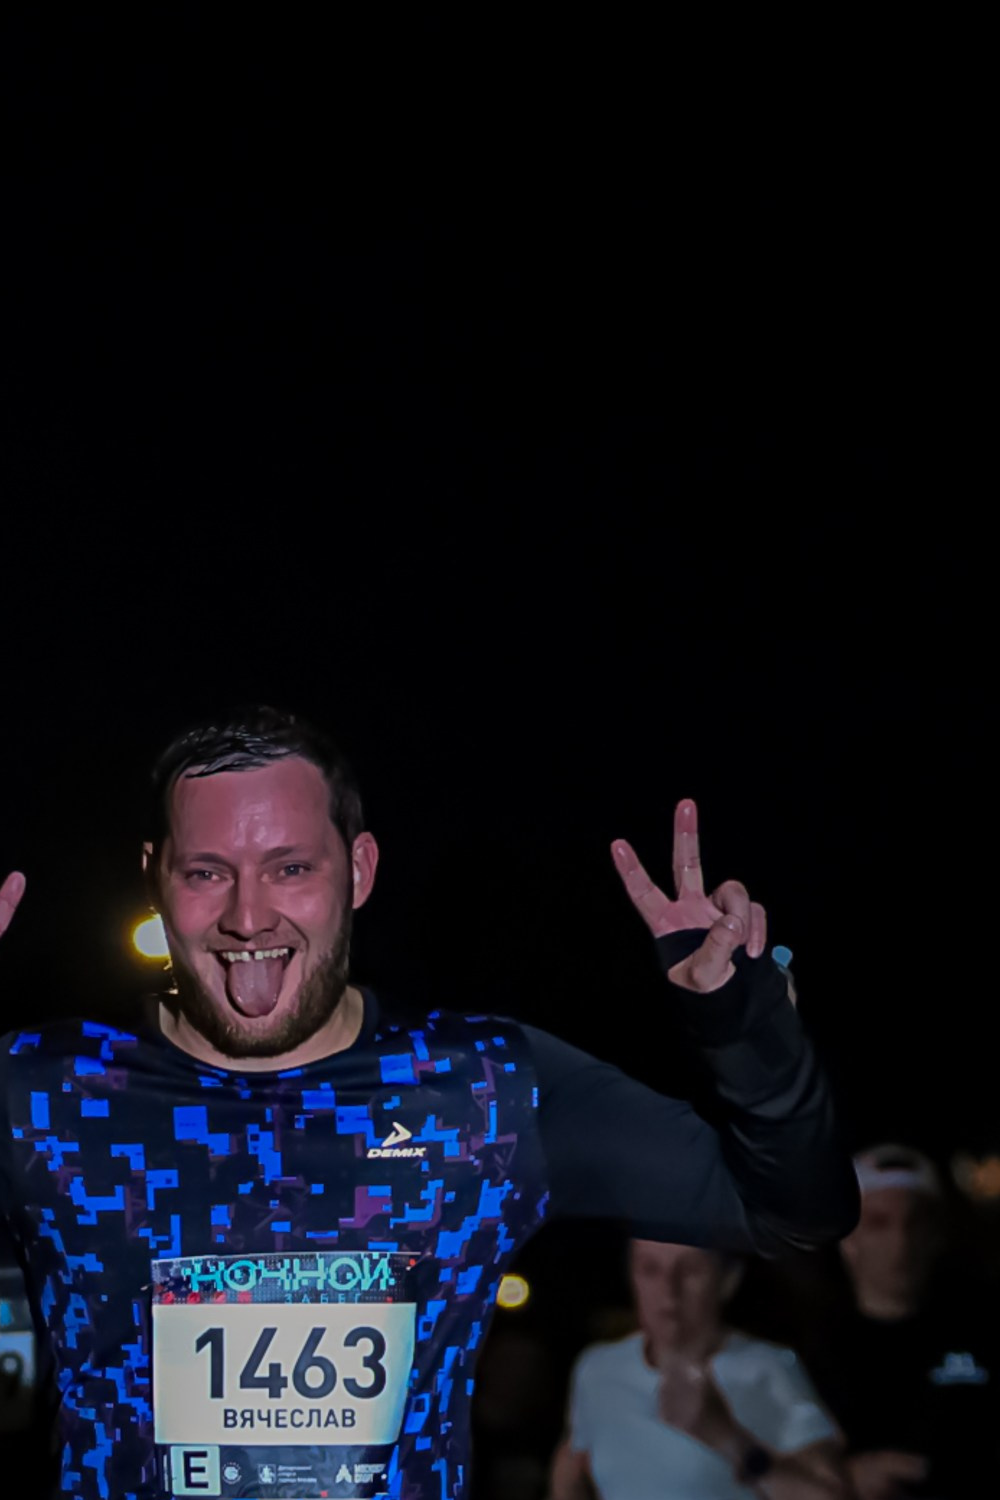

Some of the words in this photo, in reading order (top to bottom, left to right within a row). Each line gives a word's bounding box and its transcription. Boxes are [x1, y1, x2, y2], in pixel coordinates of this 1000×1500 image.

[182, 1252, 396, 1291] НОЧНОЙ
[195, 1326, 387, 1399] 1463
[223, 1408, 356, 1429] ВЯЧЕСЛАВ
[183, 1451, 208, 1489] E
